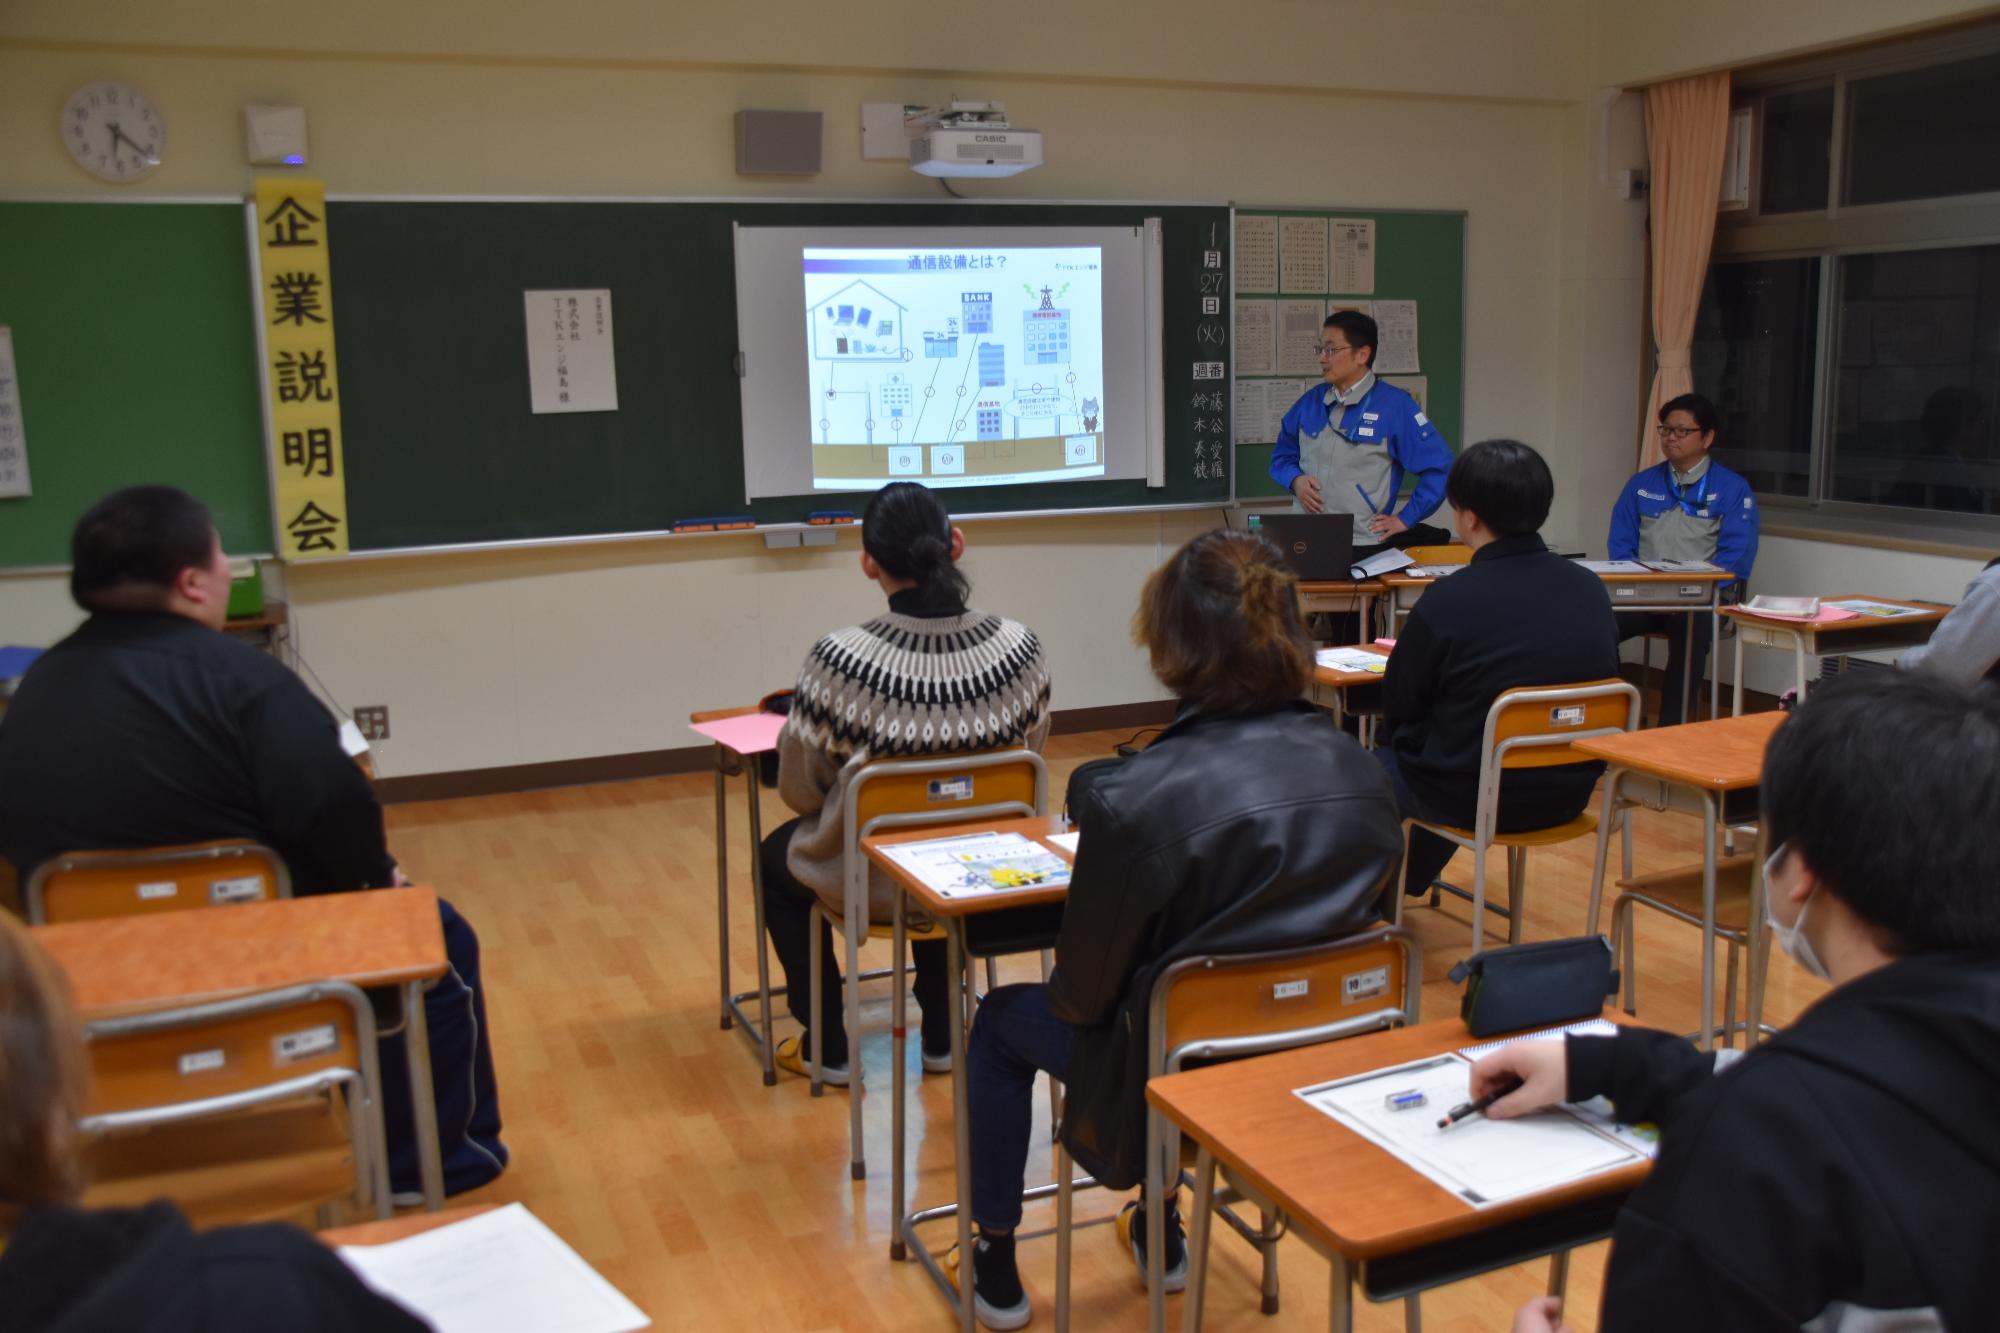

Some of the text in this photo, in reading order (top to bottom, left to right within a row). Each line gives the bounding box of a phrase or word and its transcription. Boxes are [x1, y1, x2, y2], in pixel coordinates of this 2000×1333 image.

[975, 135, 1006, 143] CASIO
[907, 254, 1007, 271] 通信設備とは？
[963, 294, 991, 303] BANK
[948, 319, 957, 327] 24
[936, 331, 946, 340] 24
[265, 196, 341, 552] 企業説明会
[1195, 363, 1222, 378] 週番
